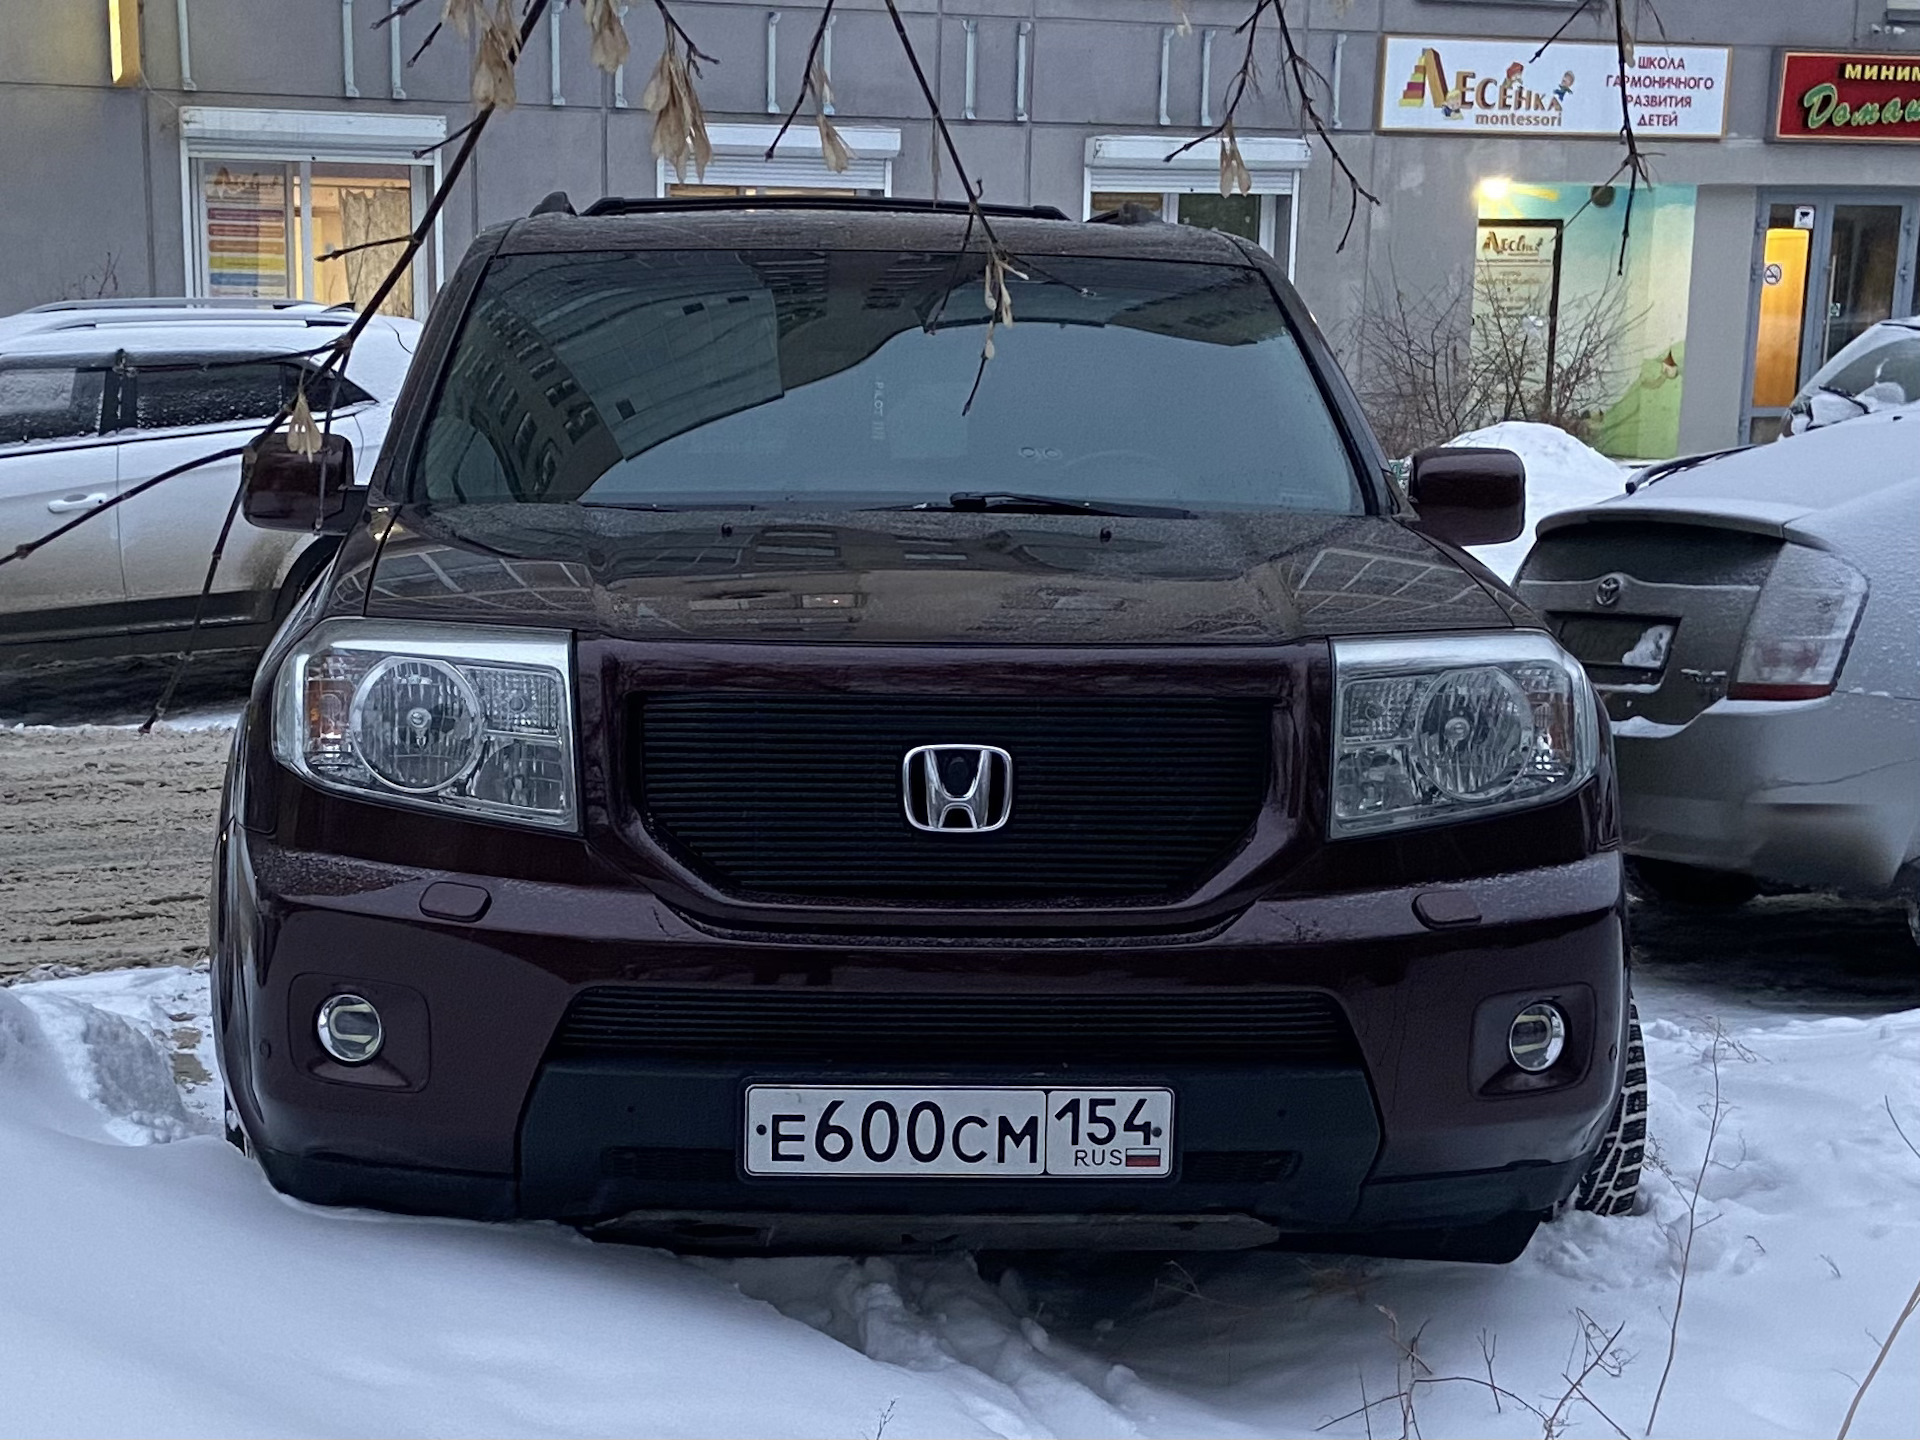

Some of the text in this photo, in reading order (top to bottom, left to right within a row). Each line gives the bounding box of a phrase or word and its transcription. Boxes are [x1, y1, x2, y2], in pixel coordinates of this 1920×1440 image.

[1637, 56, 1686, 70] ШКОЛА
[1605, 74, 1715, 91] ГАРМОНИЧНОГО
[1625, 94, 1693, 108] РАЗВИТИЯ
[1474, 112, 1563, 127] montessori
[1636, 111, 1679, 127] ДЕТЕЙ
[1054, 1097, 1152, 1146] 154
[1073, 1148, 1123, 1167] RUS
